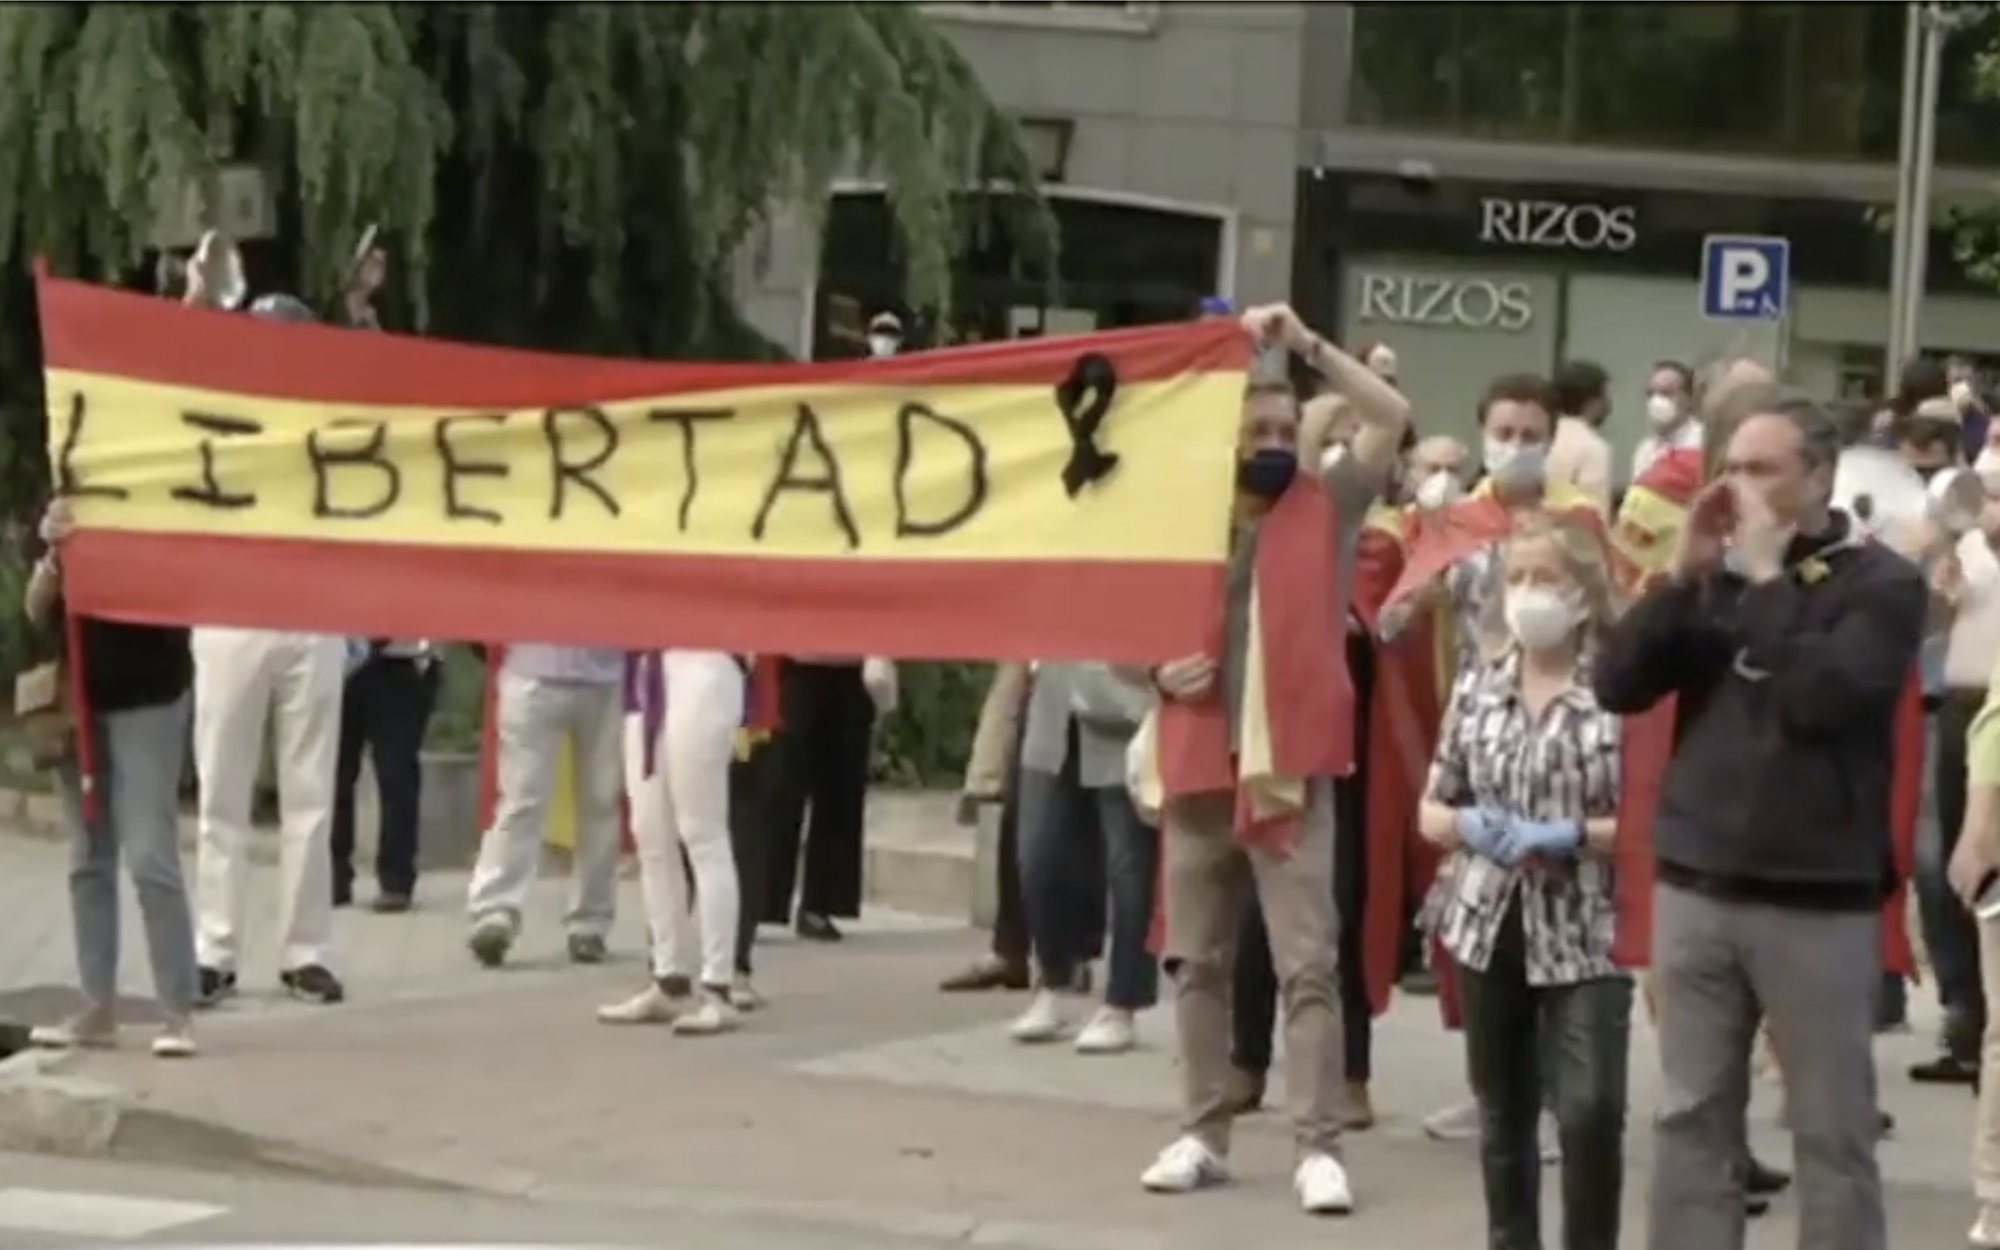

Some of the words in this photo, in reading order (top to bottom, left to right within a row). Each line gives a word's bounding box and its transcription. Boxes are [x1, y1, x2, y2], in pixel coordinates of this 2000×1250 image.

[1479, 198, 1636, 250] RIZOS
[1360, 275, 1531, 329] RIZOS
[1720, 249, 1769, 310] P
[57, 391, 988, 549] LIBERTAD
